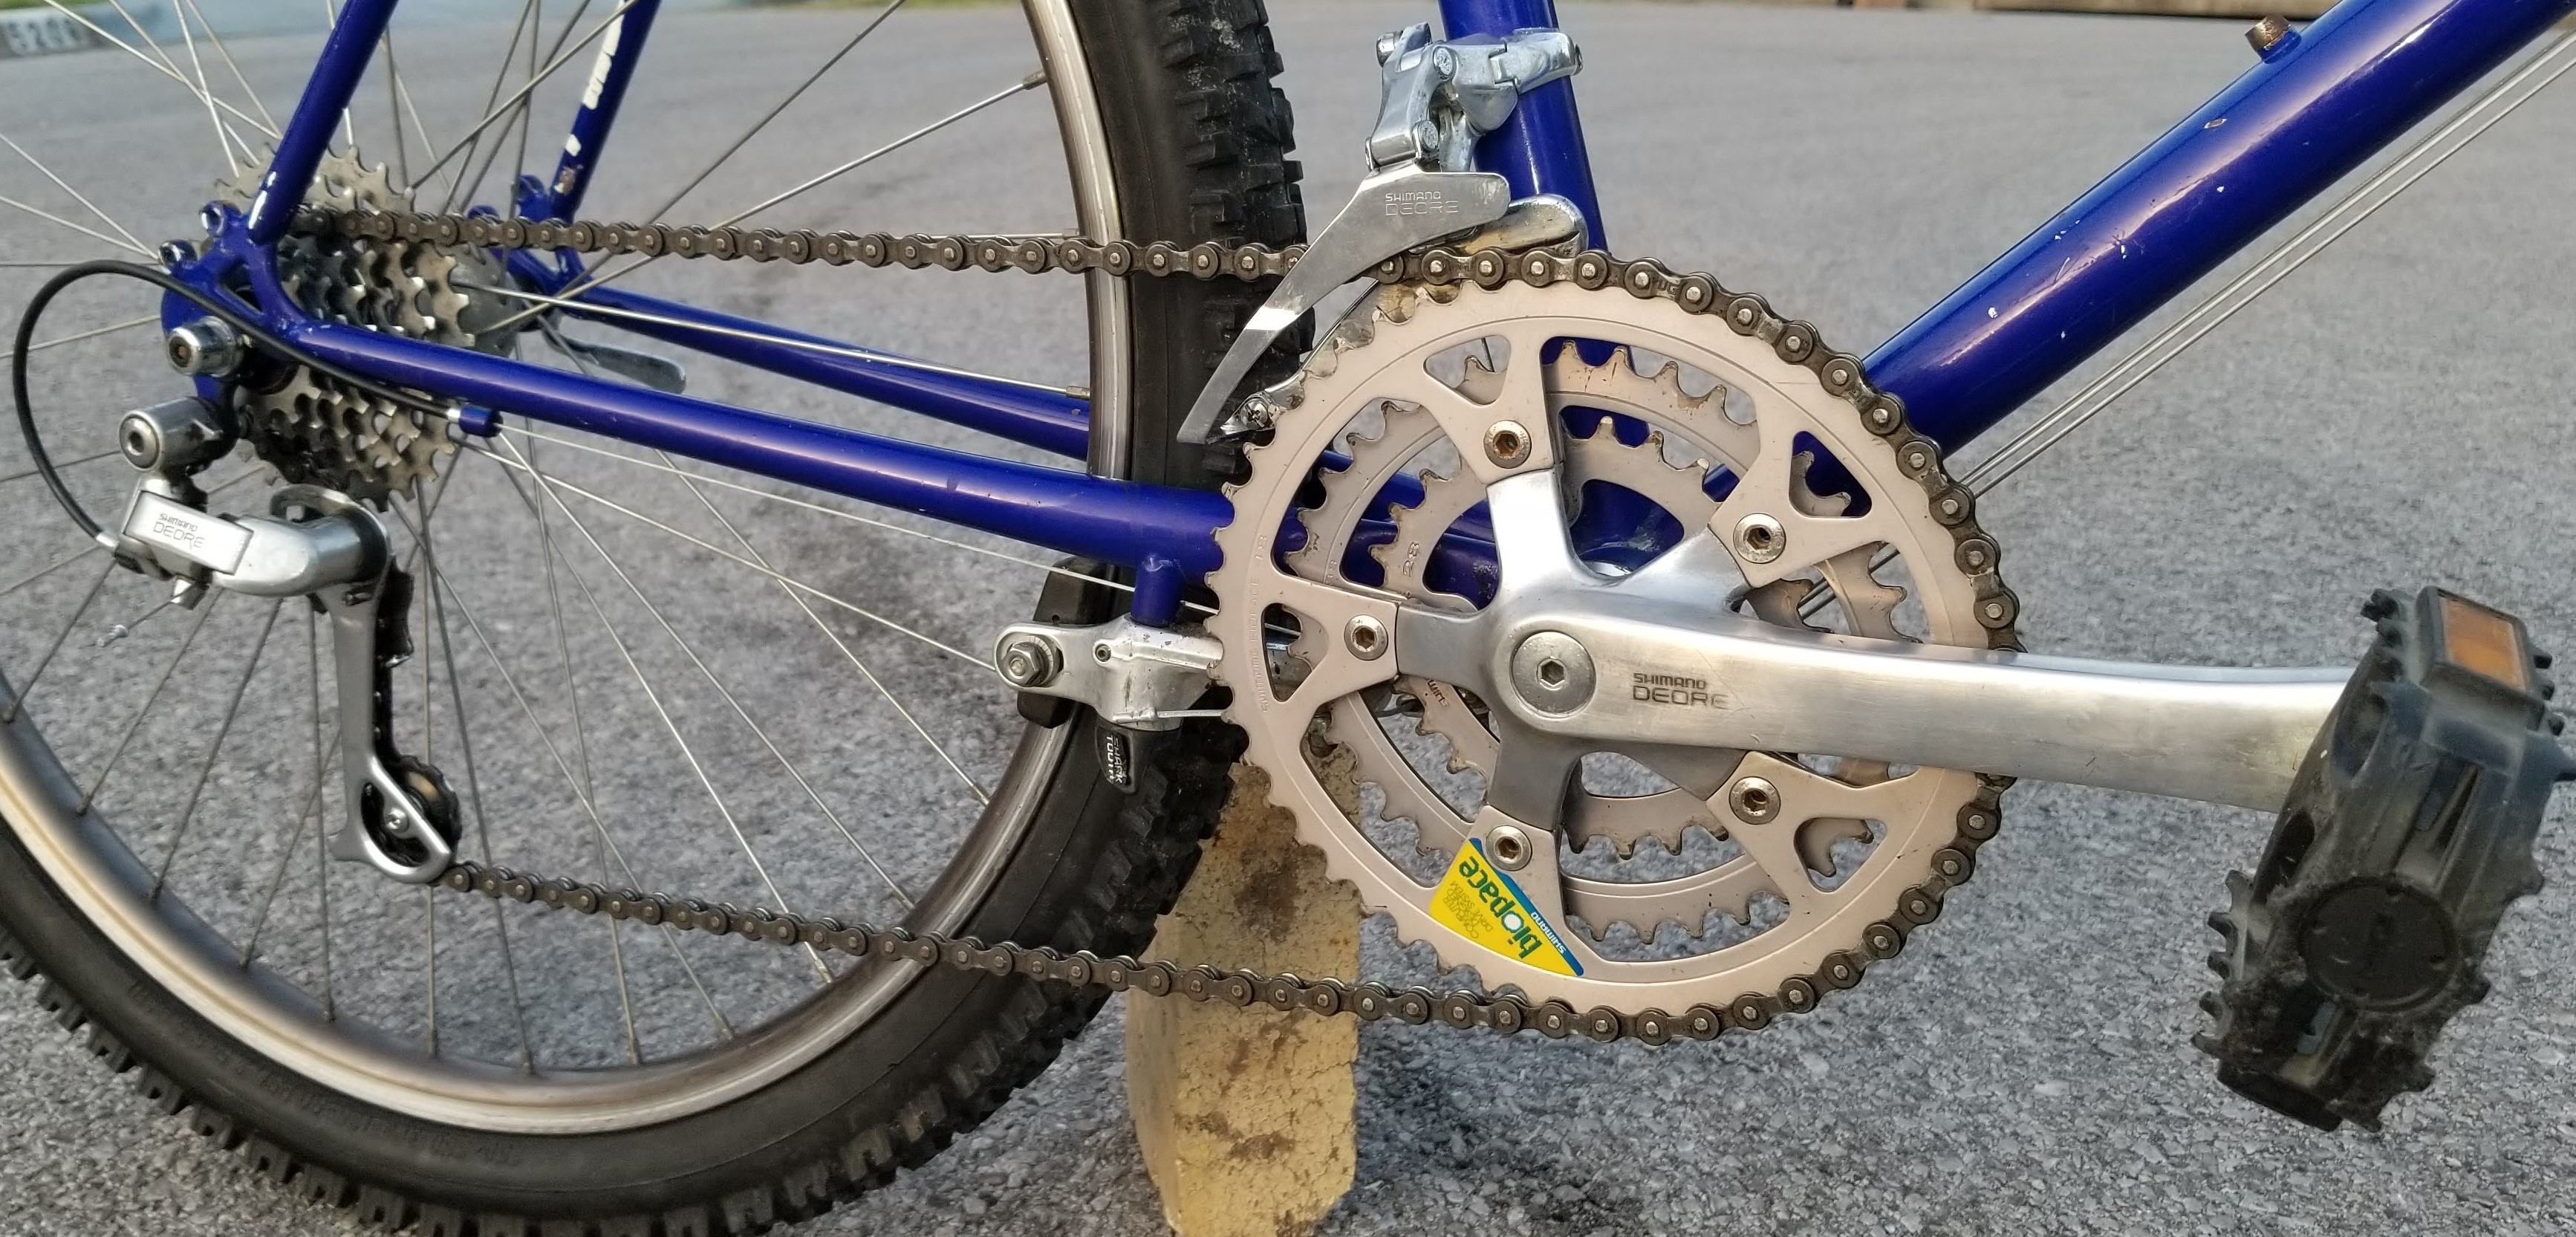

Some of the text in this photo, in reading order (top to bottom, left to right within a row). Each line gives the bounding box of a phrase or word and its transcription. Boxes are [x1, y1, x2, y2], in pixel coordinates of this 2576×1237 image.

[1385, 191, 1442, 202] SHIMANO
[1385, 200, 1459, 216] DEORE
[153, 521, 206, 548] DEORE
[160, 513, 198, 532] SHIMANO
[1402, 541, 1420, 577] 28
[1633, 672, 1708, 690] SHIMANO
[1633, 685, 1731, 711] DEORE
[1114, 737, 1123, 784] SHARK
[1459, 856, 1543, 959] biopace
[1530, 911, 1567, 954] SHIMANO
